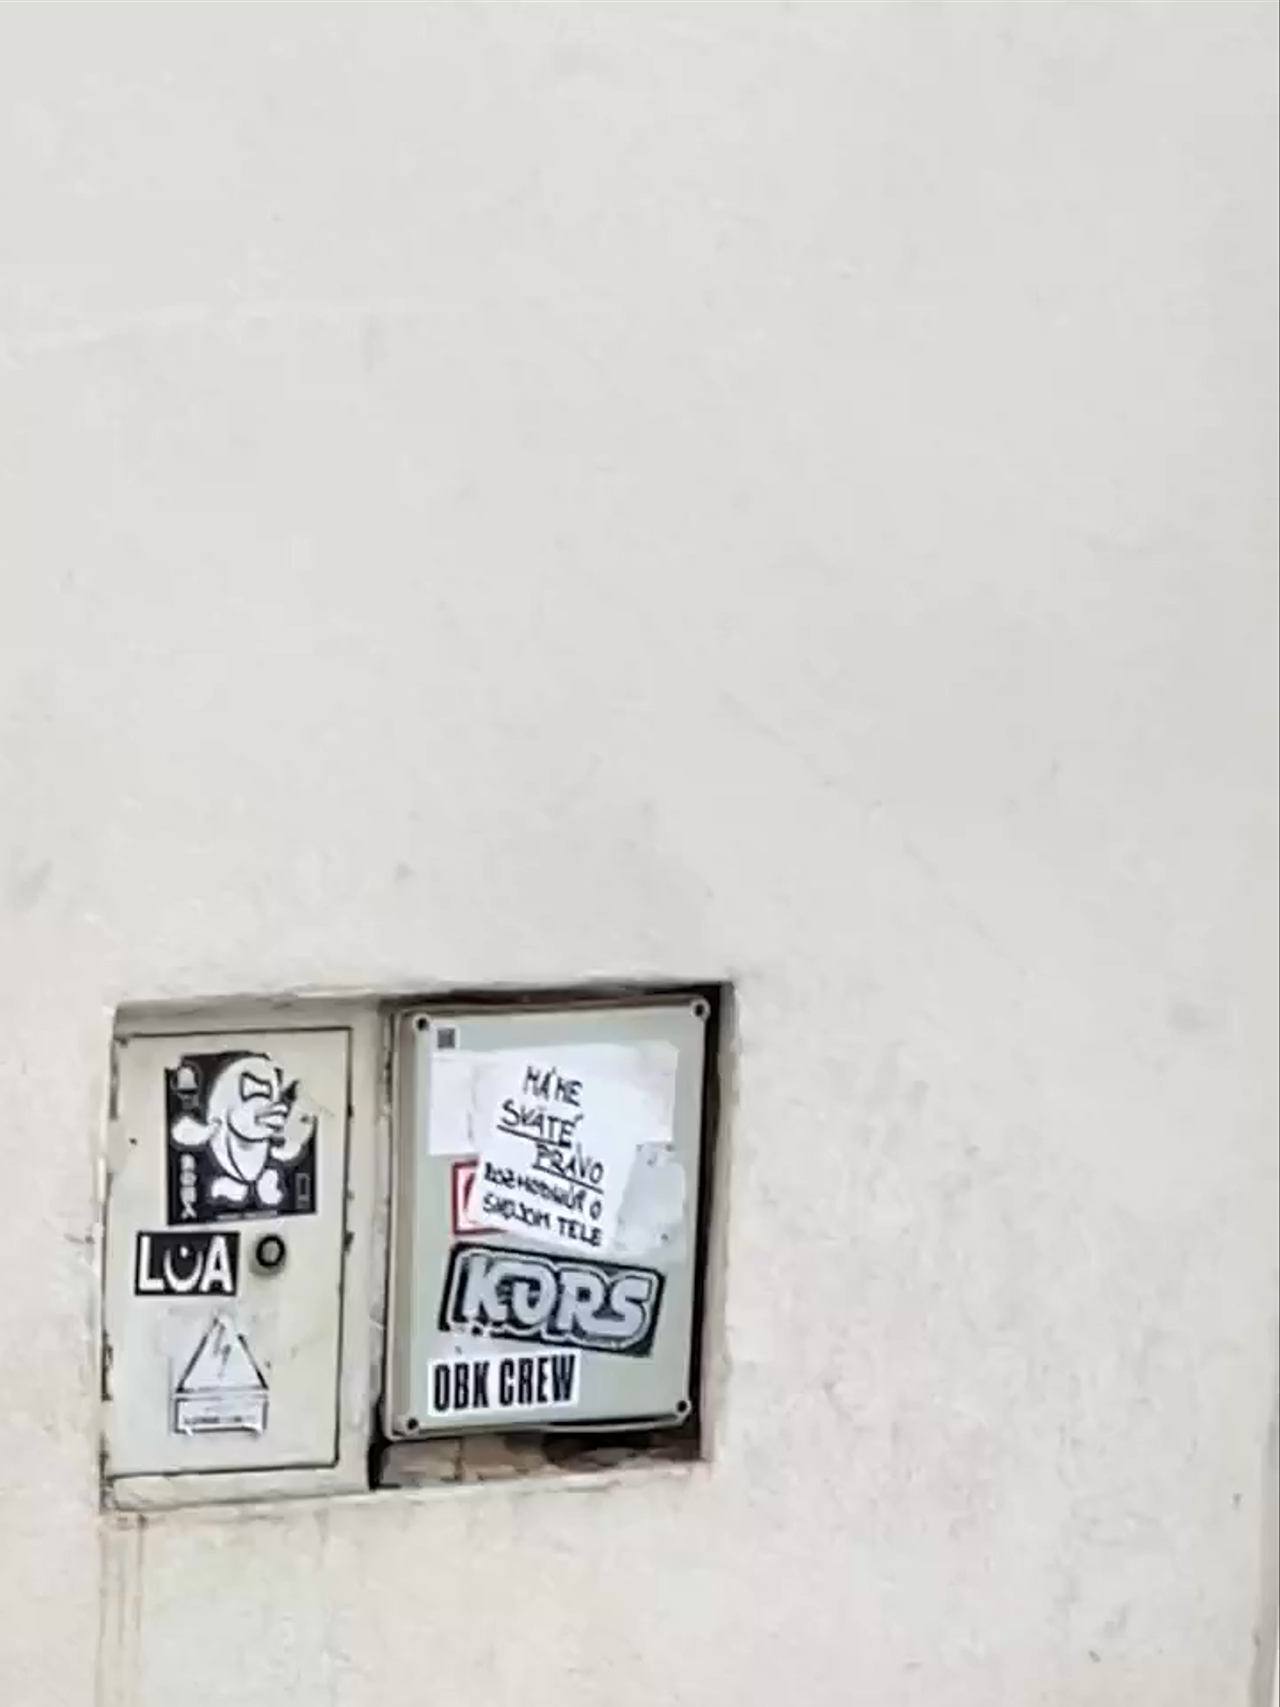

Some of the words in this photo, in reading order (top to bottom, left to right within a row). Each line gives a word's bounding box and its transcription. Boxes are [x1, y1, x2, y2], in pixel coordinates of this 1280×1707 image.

[556, 1215, 602, 1247] TELE
[139, 1235, 234, 1293] LUA
[454, 1252, 653, 1342] KORS
[433, 1361, 490, 1412] OBK
[498, 1354, 576, 1407] CREW
